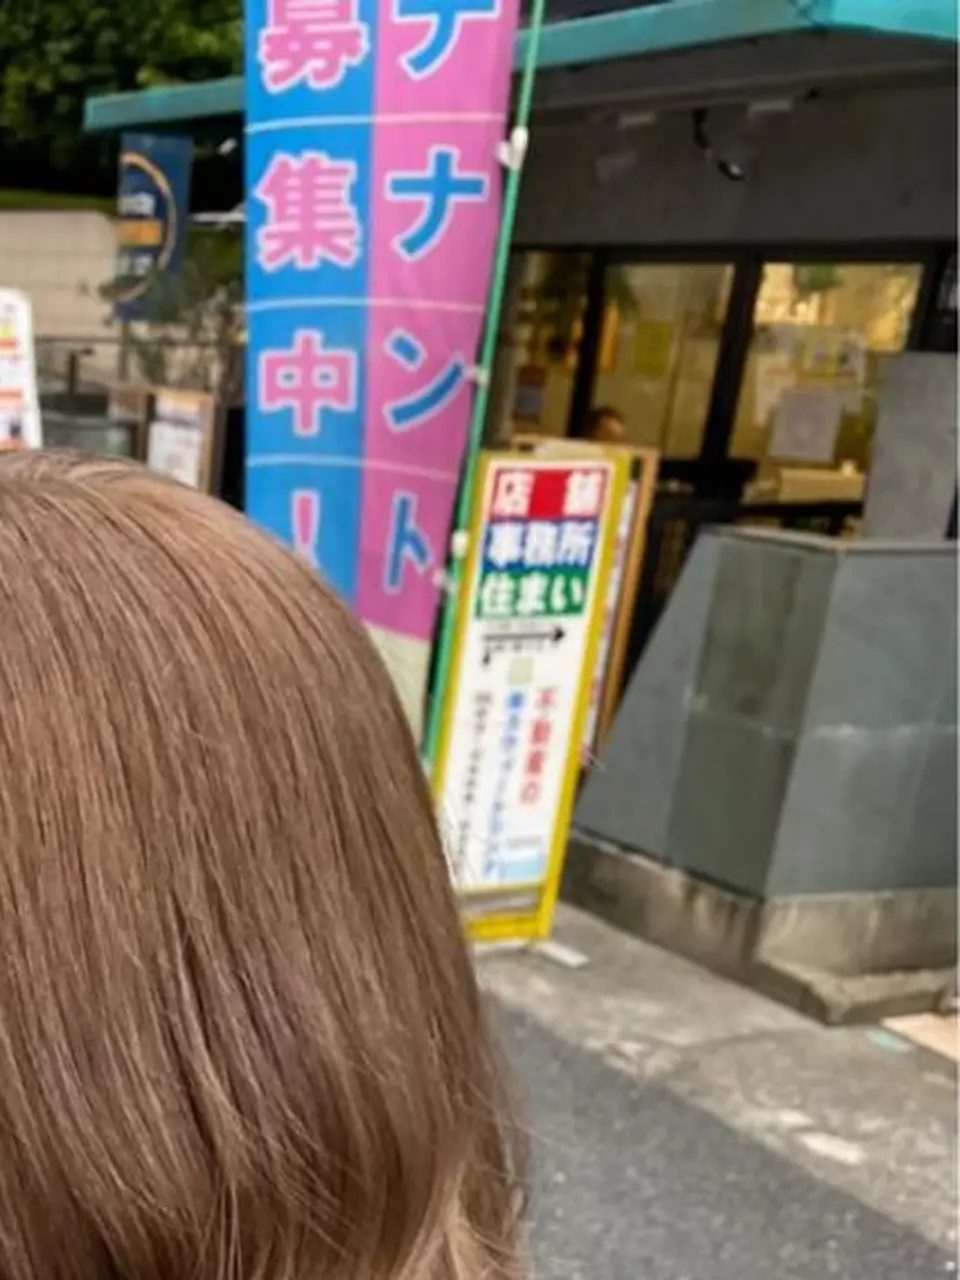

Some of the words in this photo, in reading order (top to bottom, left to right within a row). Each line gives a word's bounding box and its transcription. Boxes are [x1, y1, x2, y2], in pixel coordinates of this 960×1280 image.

[486, 520, 595, 569] 事務所
[480, 571, 586, 616] 住まい
